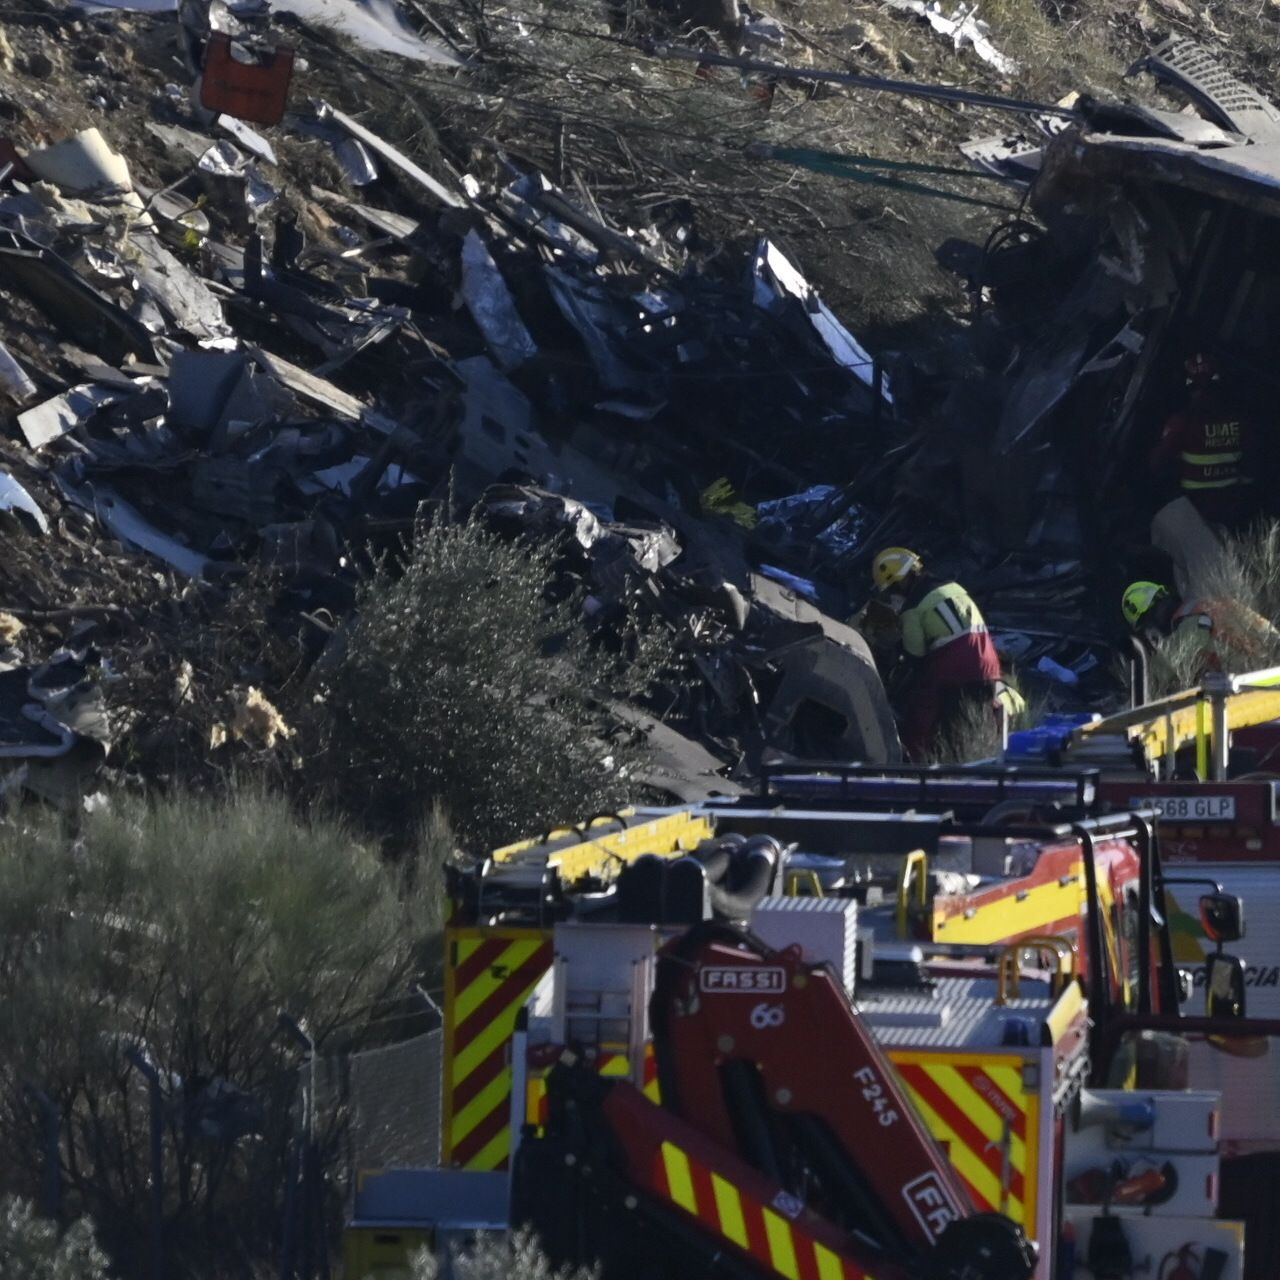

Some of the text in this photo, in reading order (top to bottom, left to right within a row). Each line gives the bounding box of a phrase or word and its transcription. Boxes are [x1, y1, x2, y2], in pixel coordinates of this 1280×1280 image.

[1195, 799, 1230, 817] GLP
[707, 971, 778, 989] FASSI
[853, 1066, 899, 1127] F245
